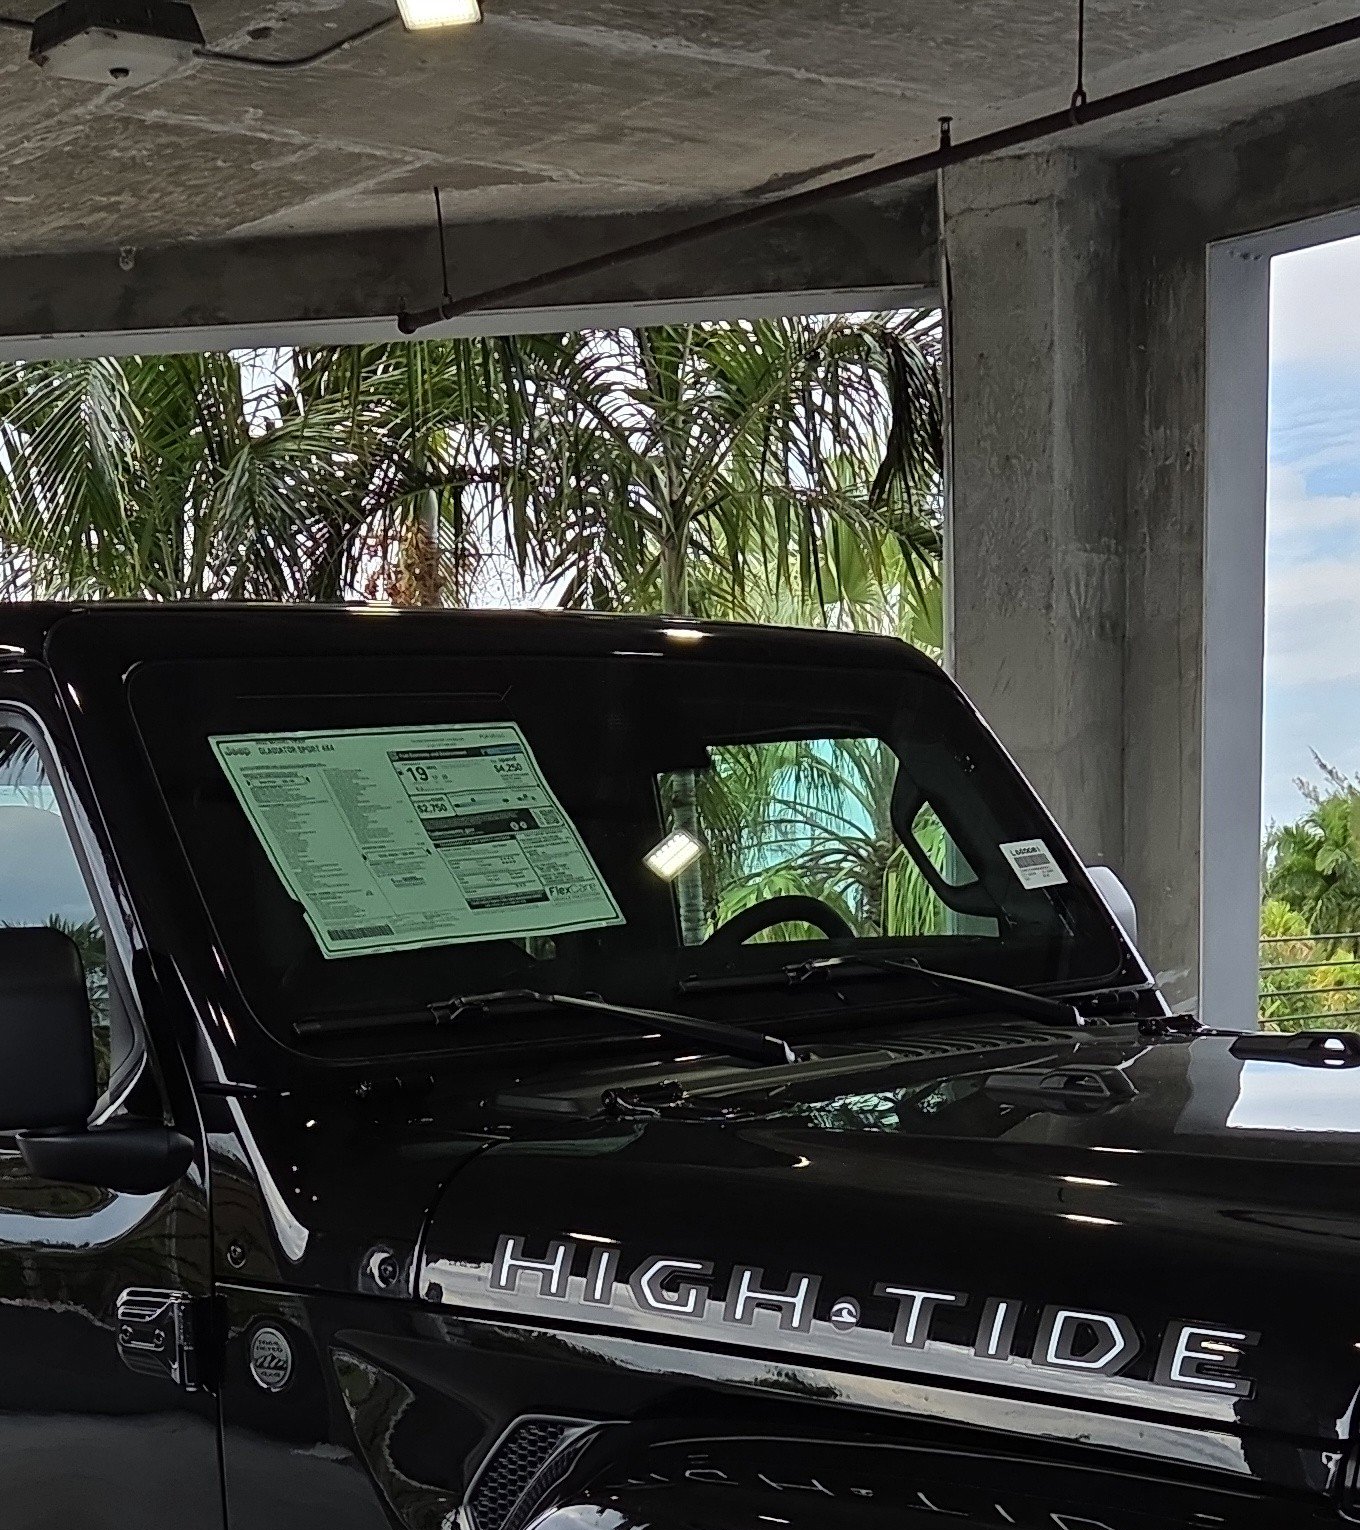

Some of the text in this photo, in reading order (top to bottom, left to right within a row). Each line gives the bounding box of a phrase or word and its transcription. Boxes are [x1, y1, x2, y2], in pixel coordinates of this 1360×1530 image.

[258, 746, 297, 755] GLADIATOR
[297, 745, 320, 754] SPORT
[493, 762, 523, 773] $4,250
[406, 766, 429, 782] 19
[417, 803, 448, 814] $2,750
[490, 1234, 1262, 1399] HIGH TIDE
